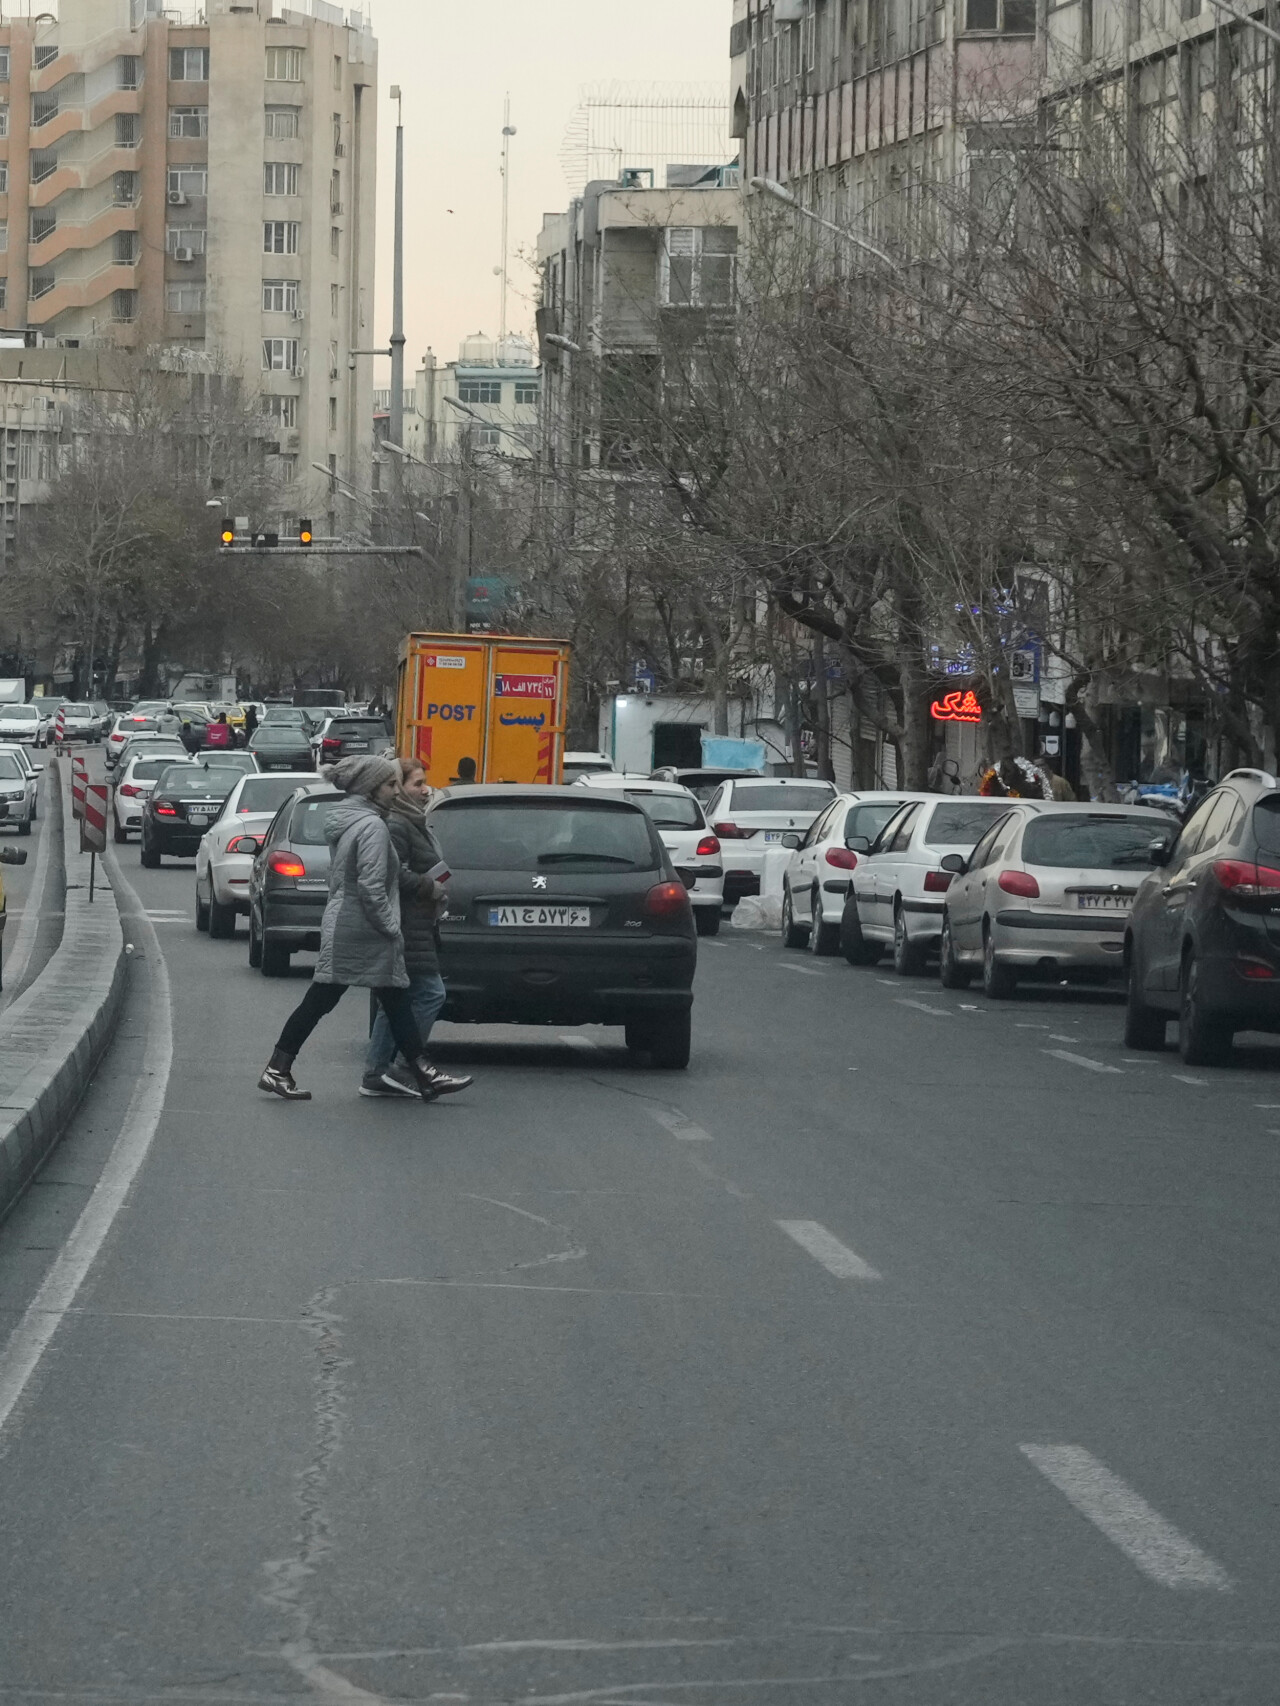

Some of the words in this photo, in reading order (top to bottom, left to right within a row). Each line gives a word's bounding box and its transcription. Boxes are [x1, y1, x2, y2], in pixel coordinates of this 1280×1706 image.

[427, 703, 476, 722] POST
[930, 691, 982, 722] شک
[500, 712, 546, 733] پست
[500, 909, 518, 924] ۸۱
[539, 908, 567, 924] ۵۷۳
[570, 911, 587, 925] ۶۰
